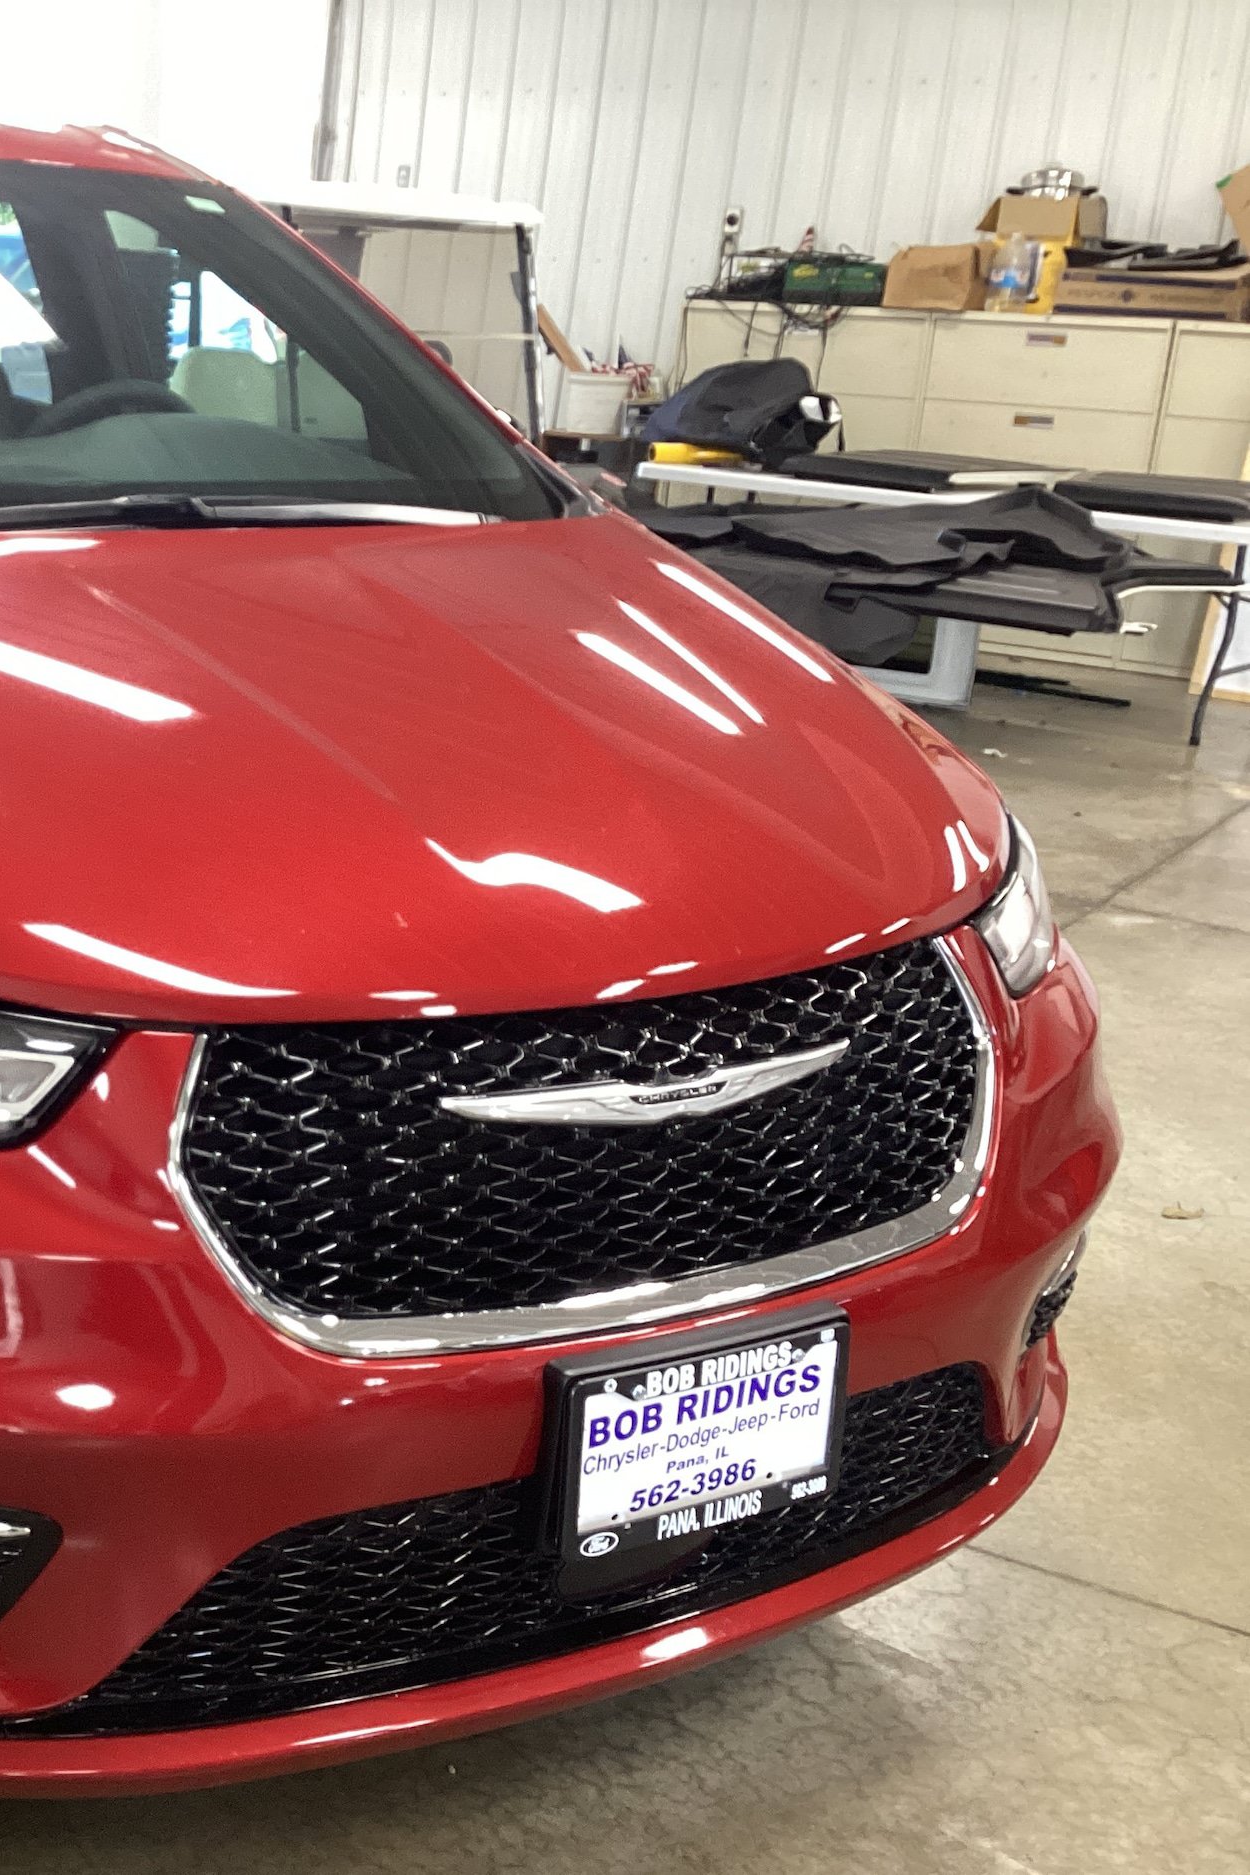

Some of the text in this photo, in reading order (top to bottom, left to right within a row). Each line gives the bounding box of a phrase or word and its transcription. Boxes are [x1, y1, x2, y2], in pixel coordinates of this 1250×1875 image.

[639, 1085, 717, 1103] CHRYSLER
[644, 1340, 793, 1400] BOB RIDINGS
[588, 1363, 822, 1449] BOB RIDINGS
[583, 1398, 820, 1475] Chrysler-Dodge-Jeep-Ford
[666, 1445, 730, 1474] Pana, IL
[629, 1458, 757, 1513] 562-3986
[704, 1489, 763, 1529] ILLINOIS
